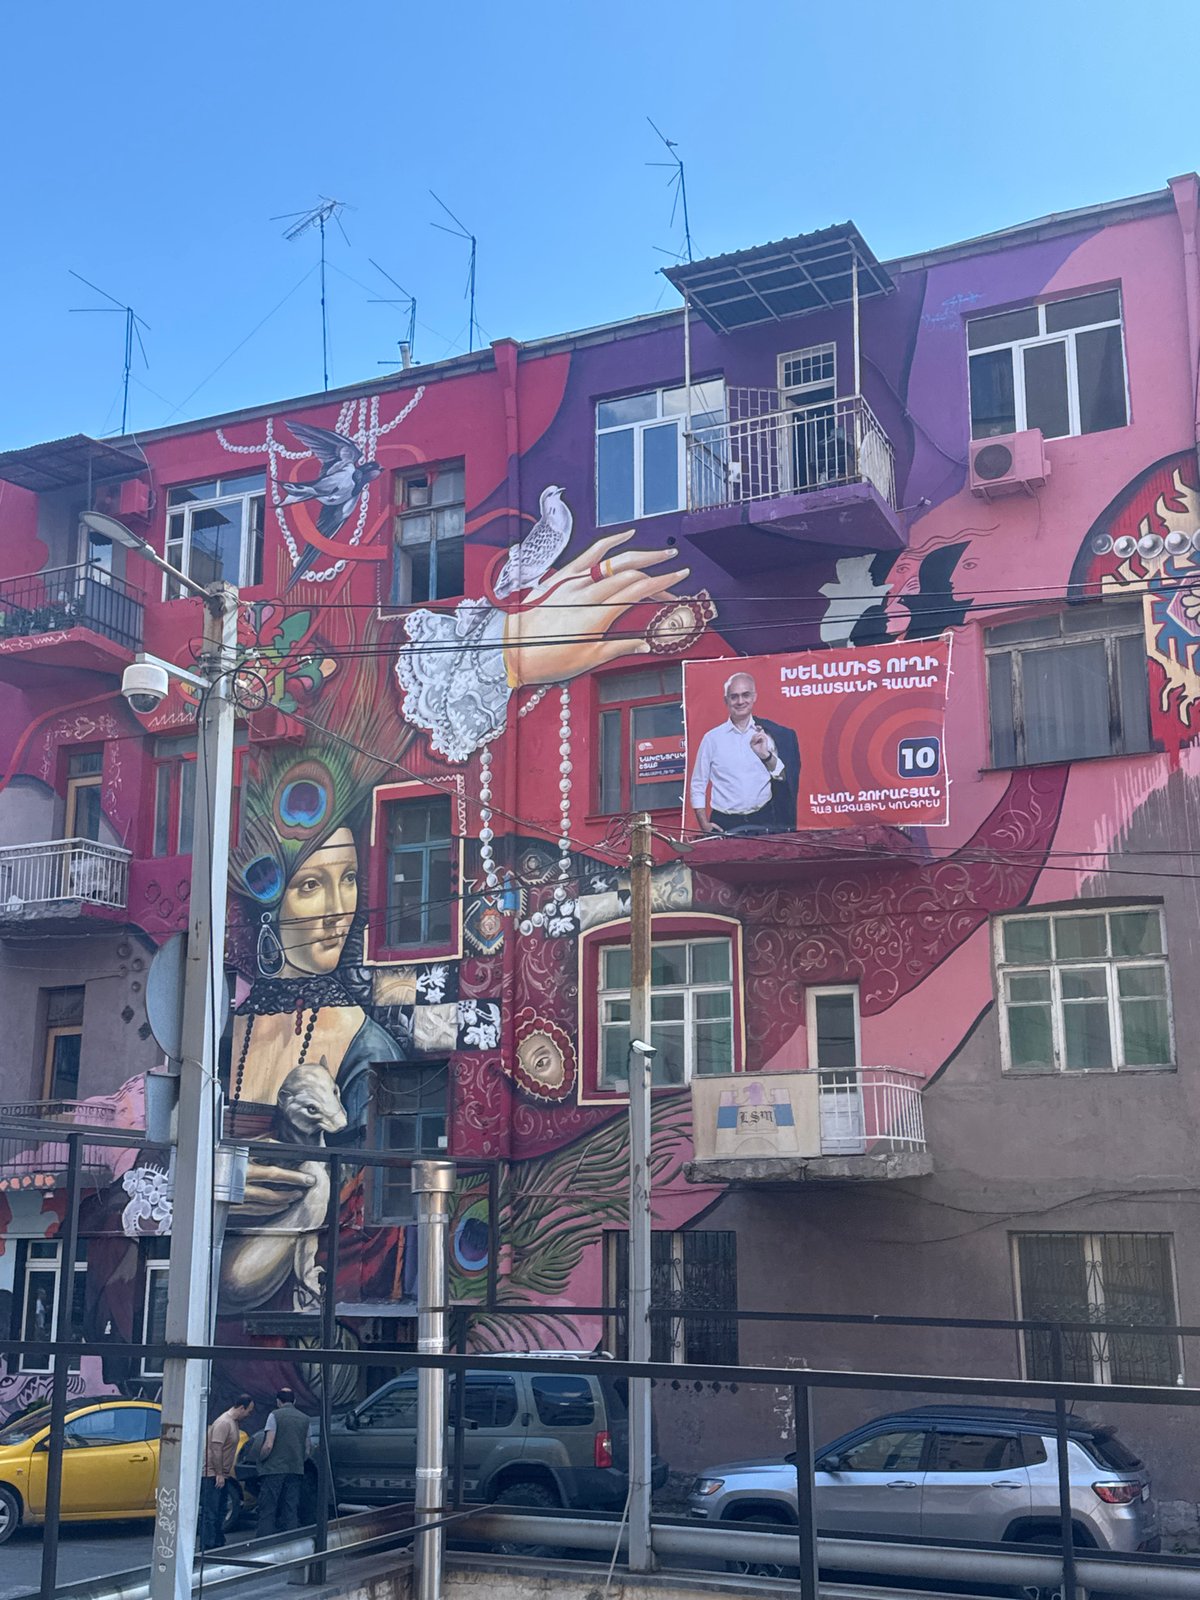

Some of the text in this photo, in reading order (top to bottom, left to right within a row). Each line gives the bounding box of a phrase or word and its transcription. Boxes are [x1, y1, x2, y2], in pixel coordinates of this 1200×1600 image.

[780, 655, 939, 682] ԽԵԼԱՄԻՏ ՈՒՂԻ
[781, 675, 939, 698] ՀԱՅԱՍՏԱՆԻ ՀԱՄԱՐ
[901, 746, 936, 770] 10
[809, 786, 941, 805] ԼԵՎՈՆ ԶՈՒՐԱԲՅԱՆ
[810, 798, 940, 815] ՀԱՅ ԱԶԳԱՅԻՆ ԿՈՆԳՐԵՍ
